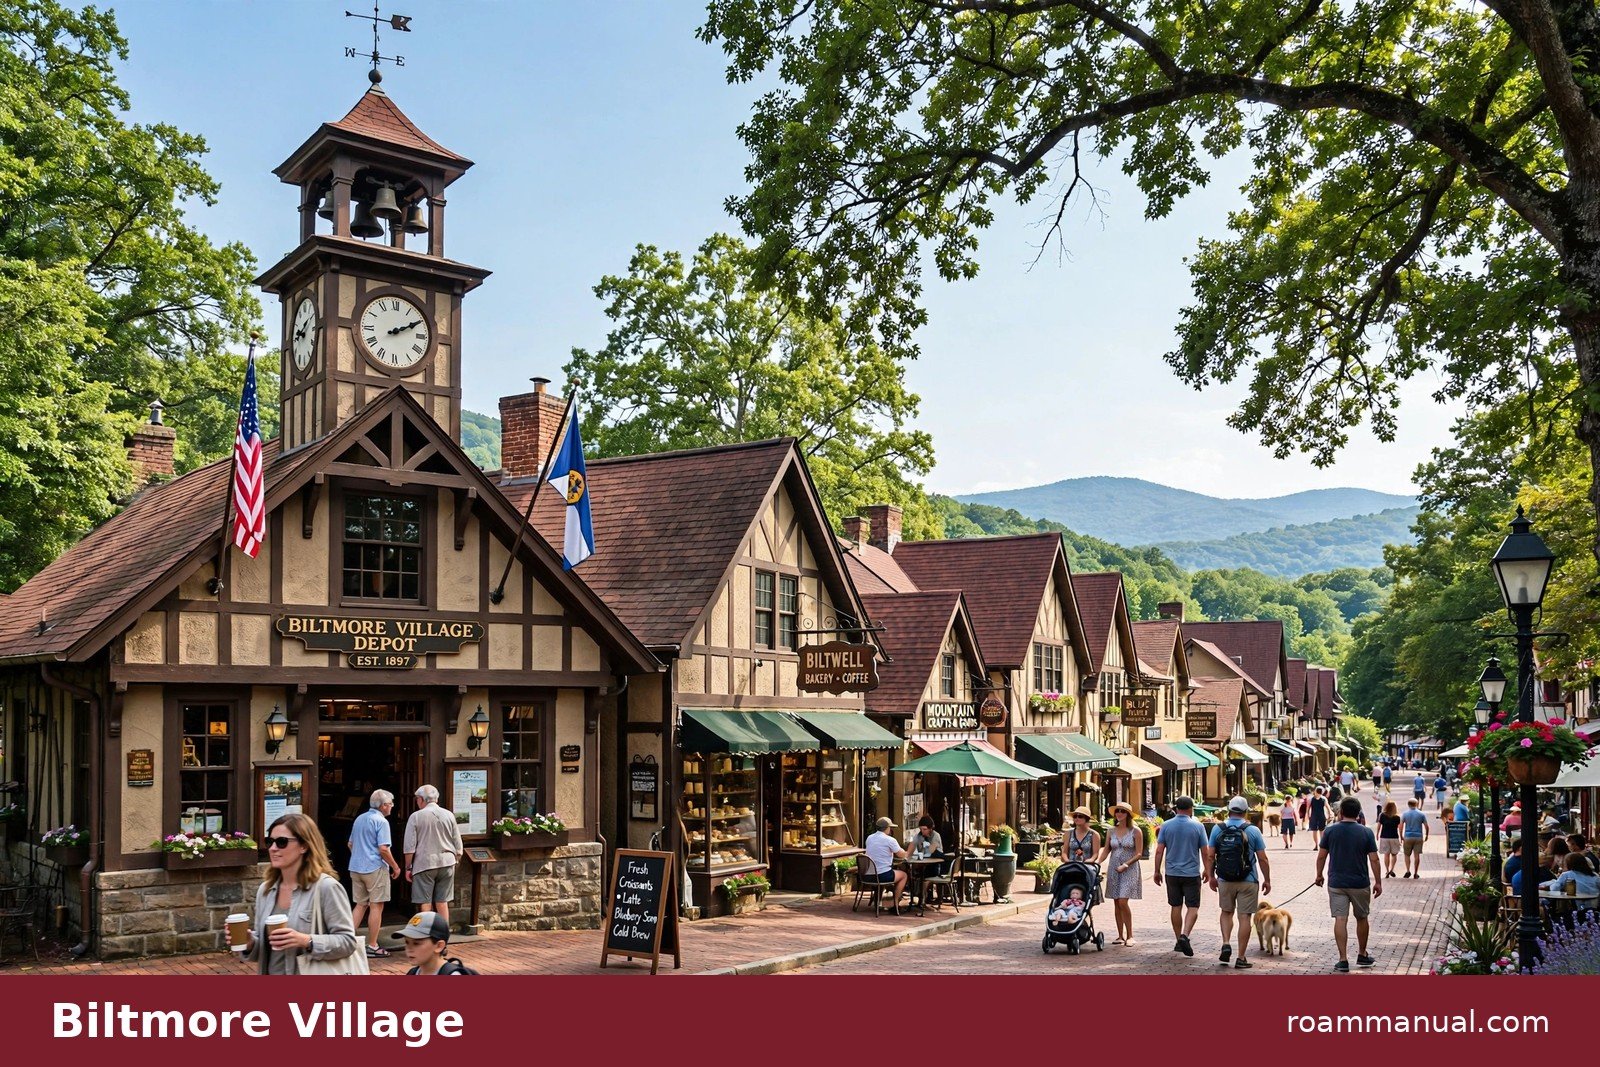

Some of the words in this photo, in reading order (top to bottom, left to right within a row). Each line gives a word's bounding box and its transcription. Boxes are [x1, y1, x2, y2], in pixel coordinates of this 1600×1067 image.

[288, 618, 387, 635] BILTMORE
[396, 621, 474, 638] VILLAGE
[353, 636, 418, 652] DEPOT
[357, 656, 381, 666] EST.
[385, 656, 410, 666] 1897
[806, 651, 864, 668] BILTWELL
[805, 673, 834, 684] BAKERY
[842, 672, 869, 684] COFFEE
[927, 703, 975, 717] MOUNTAIN
[628, 861, 648, 875] Fresh
[622, 892, 641, 905] Latte
[613, 924, 630, 937] Cold
[631, 926, 651, 940] Brew
